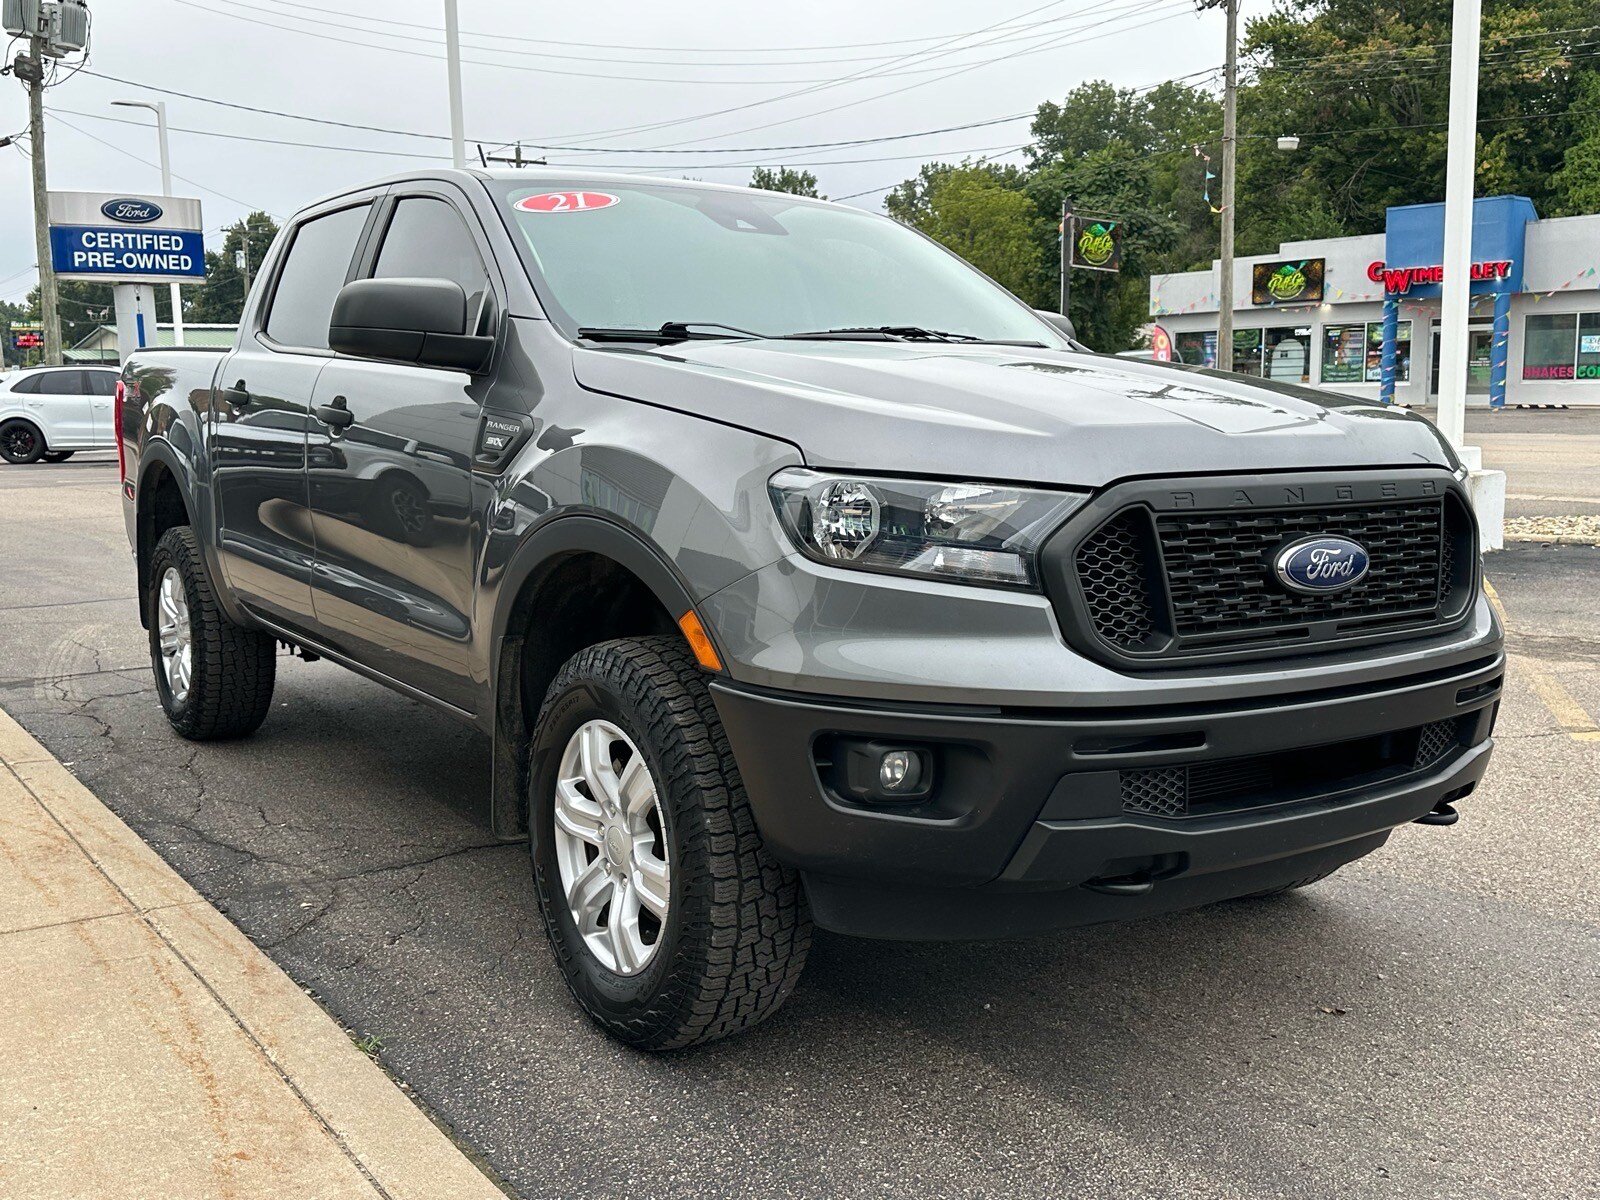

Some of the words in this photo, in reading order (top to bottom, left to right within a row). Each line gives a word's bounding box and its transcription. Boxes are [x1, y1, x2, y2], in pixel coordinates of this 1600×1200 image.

[115, 203, 150, 218] Ford
[547, 192, 591, 211] 21
[81, 231, 184, 251] CERTIFIED
[73, 251, 193, 271] PRE-OWNED
[486, 420, 520, 433] RANGER
[1169, 480, 1437, 508] RANGER
[1306, 548, 1354, 580] Ford
